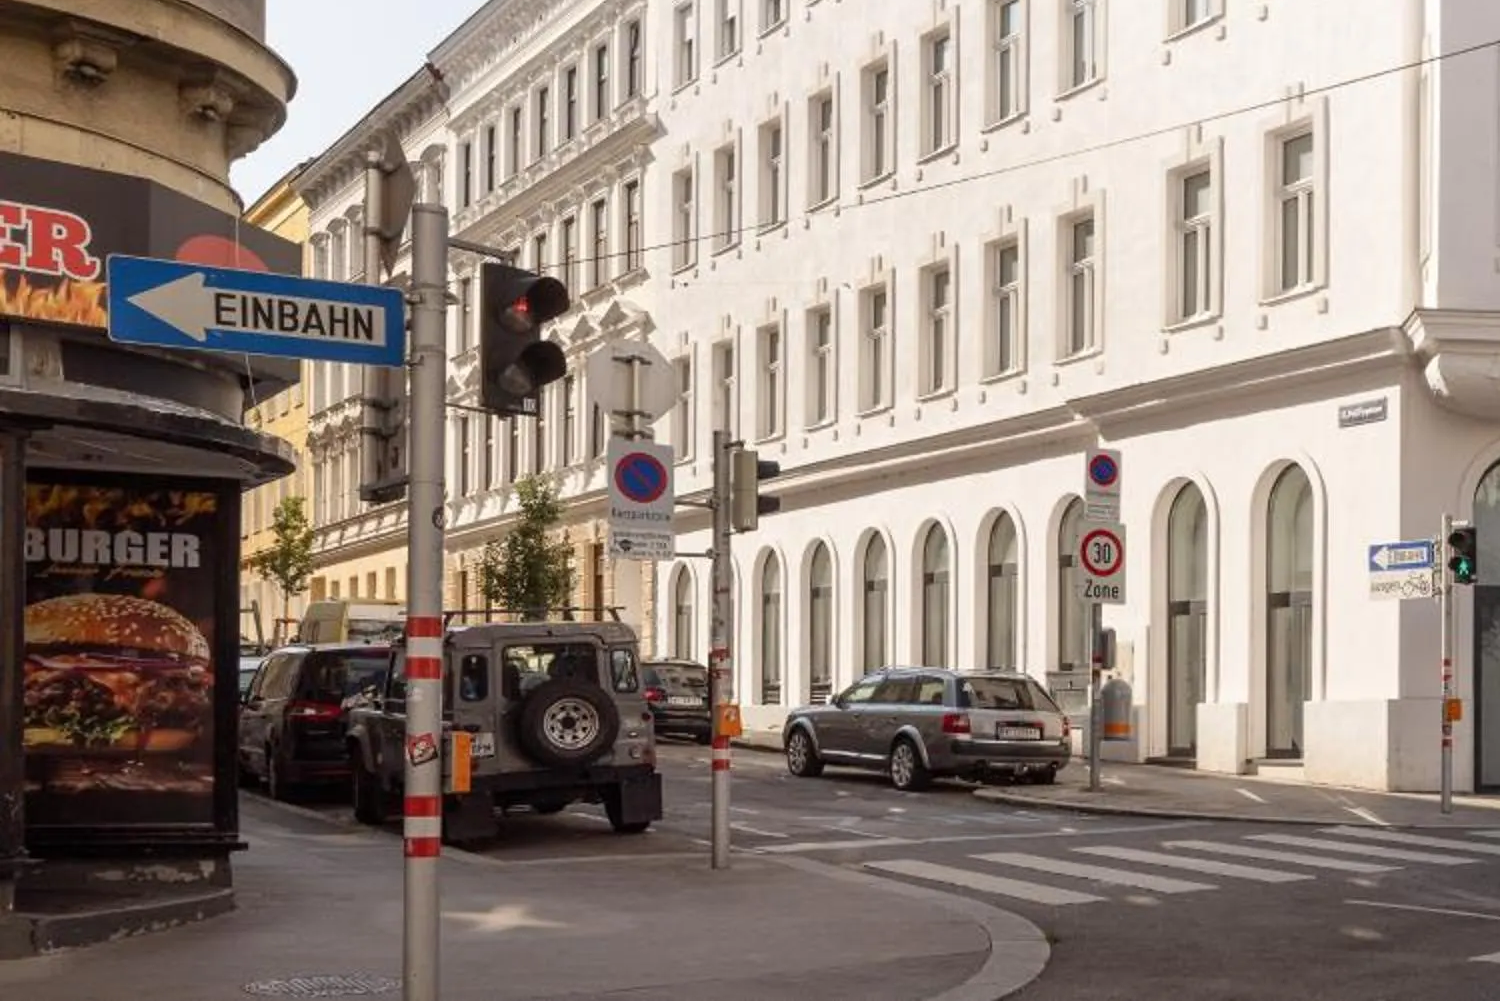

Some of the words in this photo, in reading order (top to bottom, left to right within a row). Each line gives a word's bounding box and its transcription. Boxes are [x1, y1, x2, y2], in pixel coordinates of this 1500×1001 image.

[213, 292, 374, 341] EINBAHN
[24, 527, 200, 568] BURGER
[1093, 542, 1111, 563] 30
[1084, 579, 1119, 599] Zone
